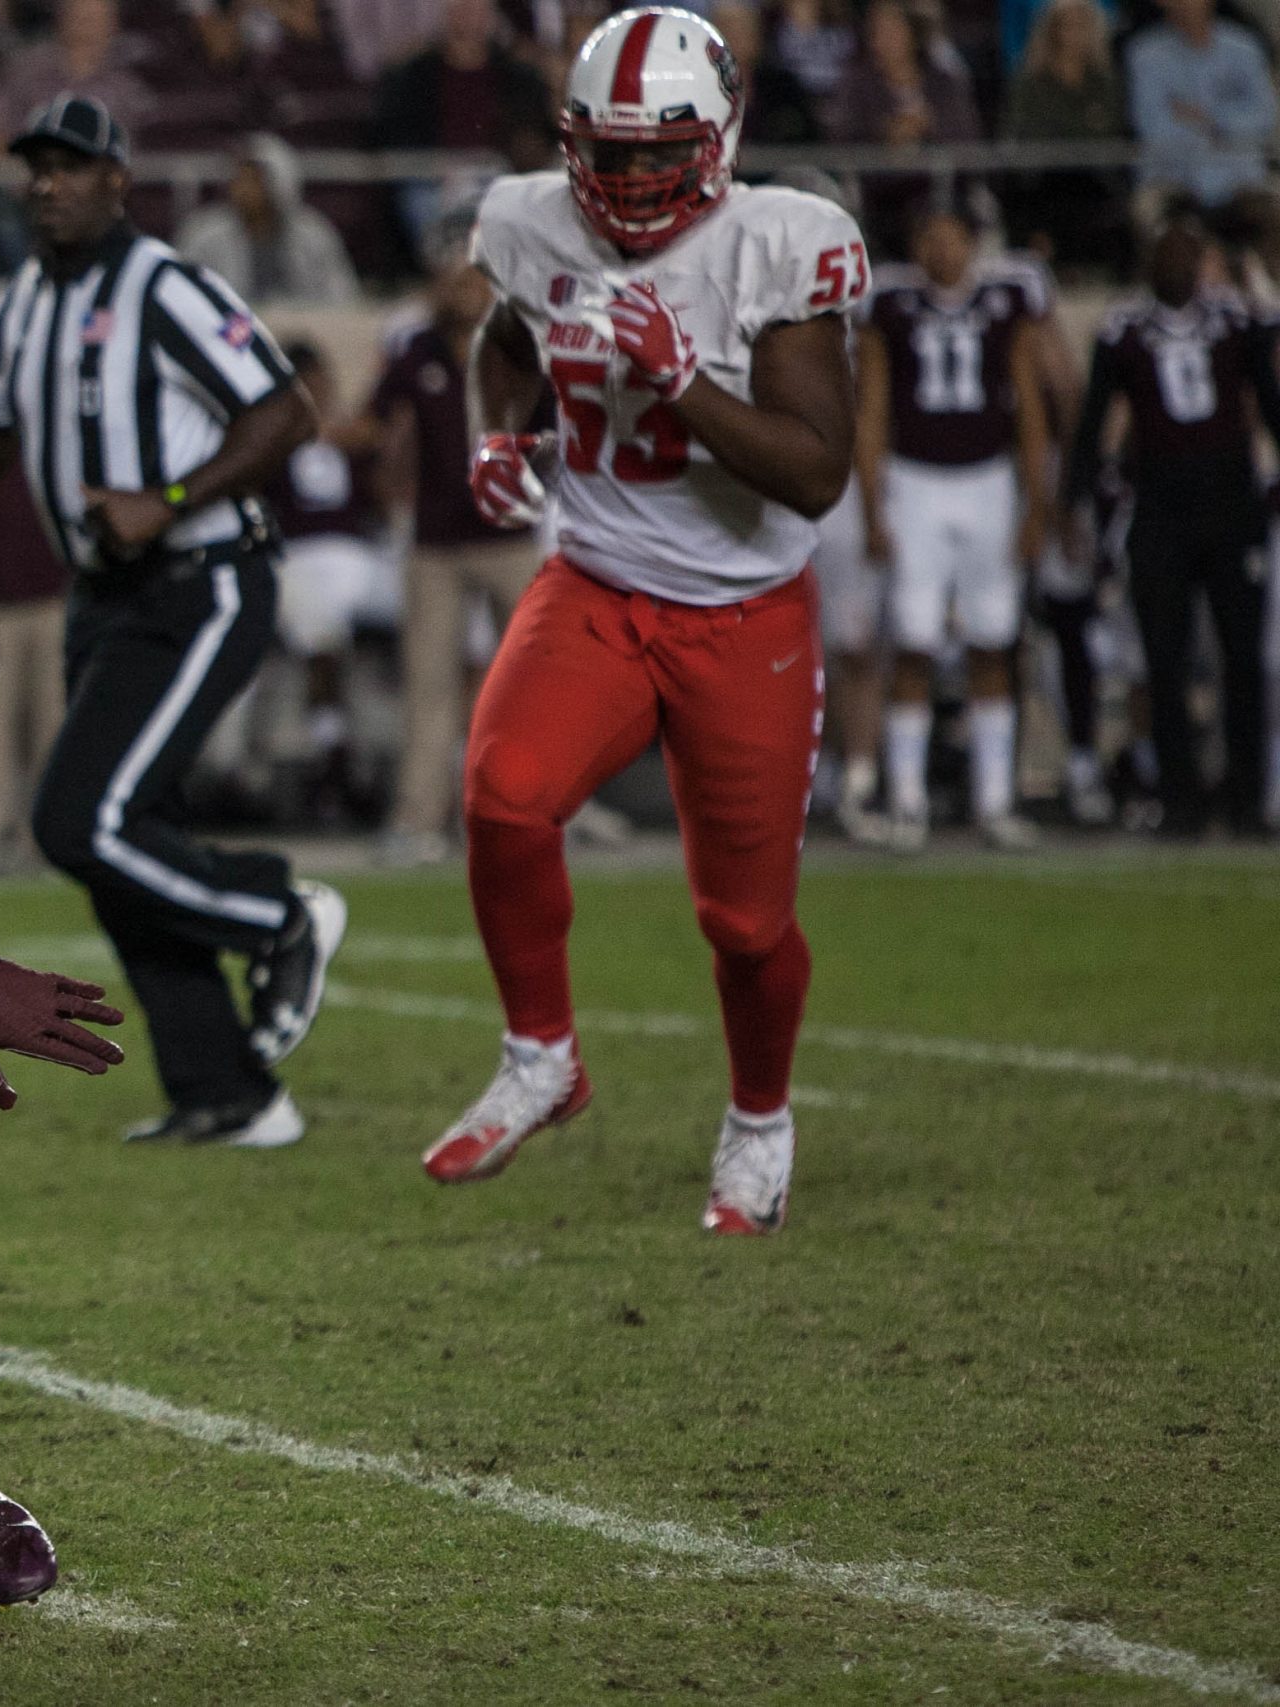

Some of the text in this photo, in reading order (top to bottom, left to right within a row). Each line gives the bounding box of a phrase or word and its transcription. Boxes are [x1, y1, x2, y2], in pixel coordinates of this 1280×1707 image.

[809, 242, 867, 306] 53
[915, 325, 984, 413] 11
[550, 357, 688, 484] 53
